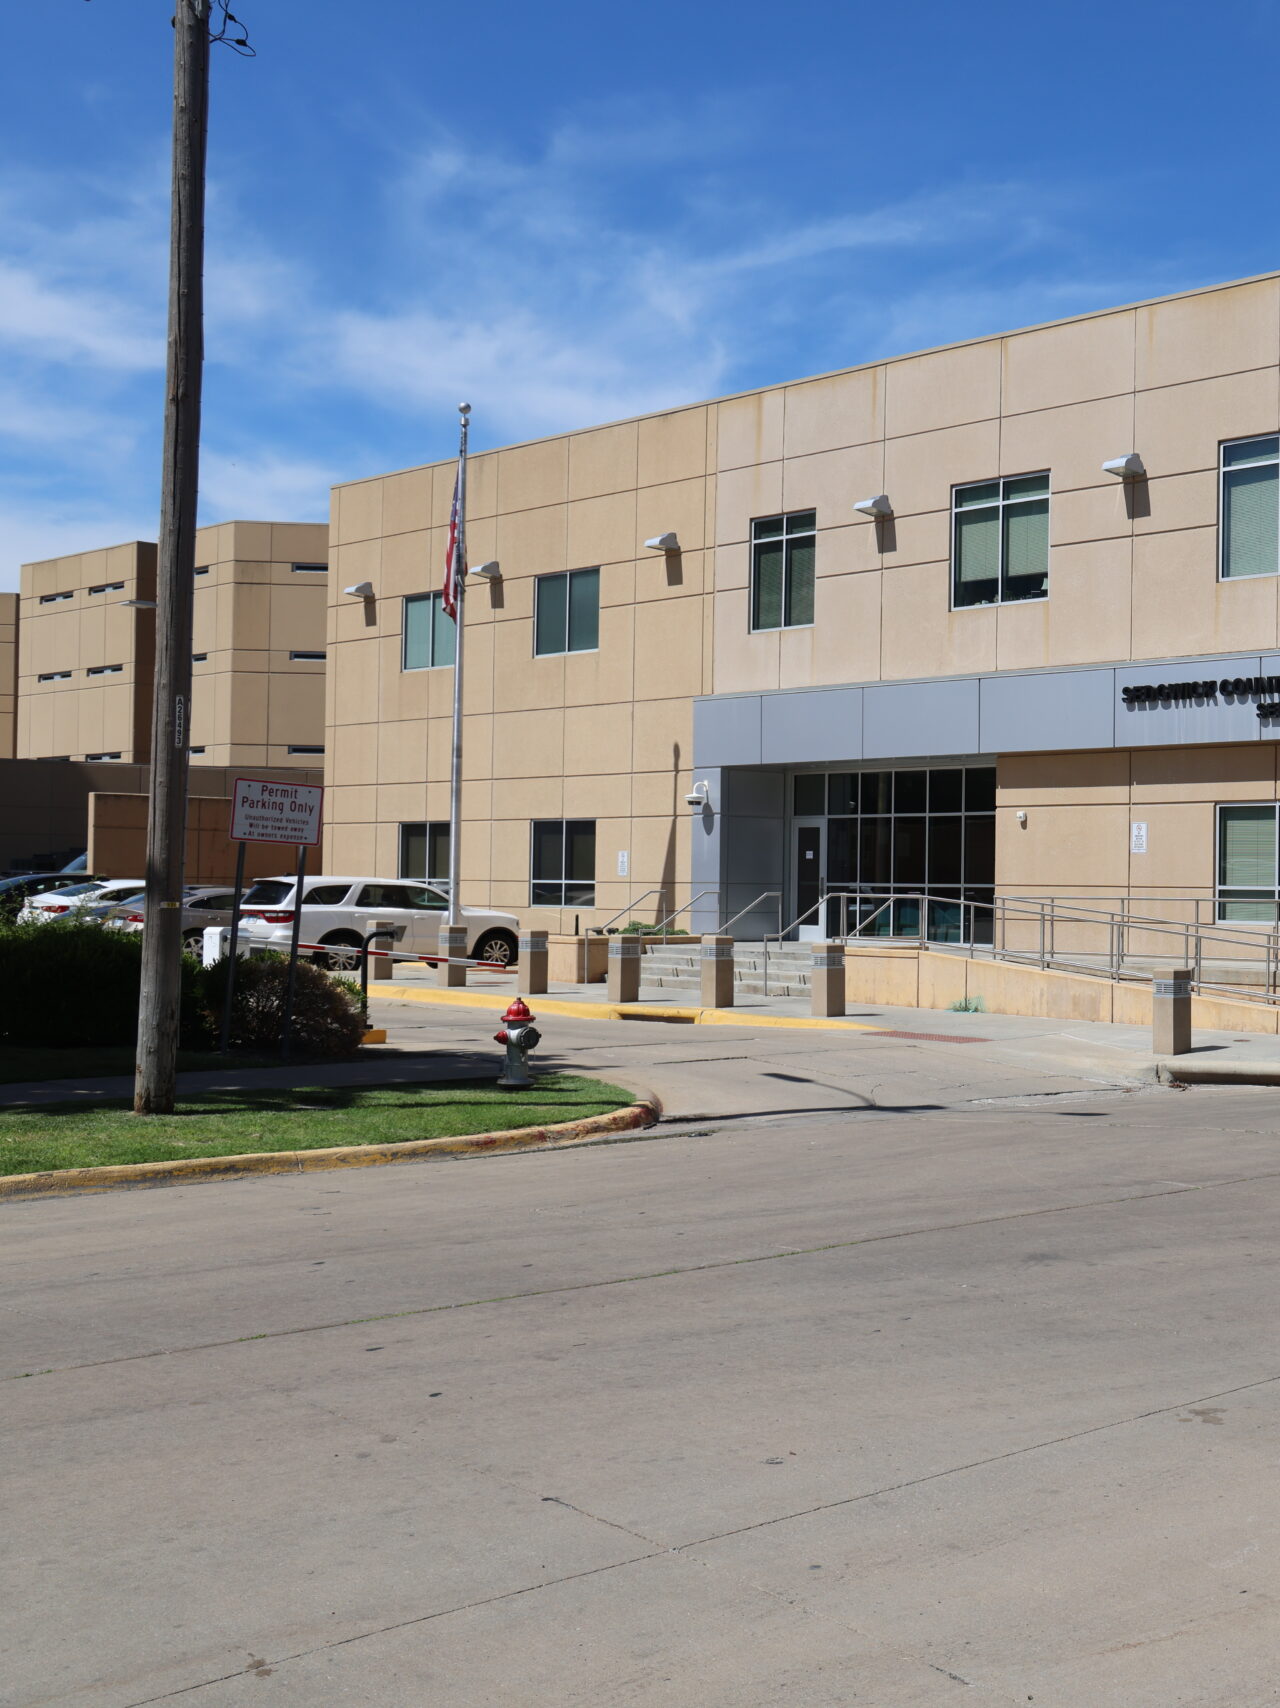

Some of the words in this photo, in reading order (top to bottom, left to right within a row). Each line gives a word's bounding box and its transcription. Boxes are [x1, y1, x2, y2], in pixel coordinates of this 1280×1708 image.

[1122, 680, 1218, 703] SEDGWICK
[261, 784, 298, 799] Permit
[241, 796, 284, 814] Parking
[289, 801, 315, 816] Only
[244, 814, 283, 823] Unauthorized
